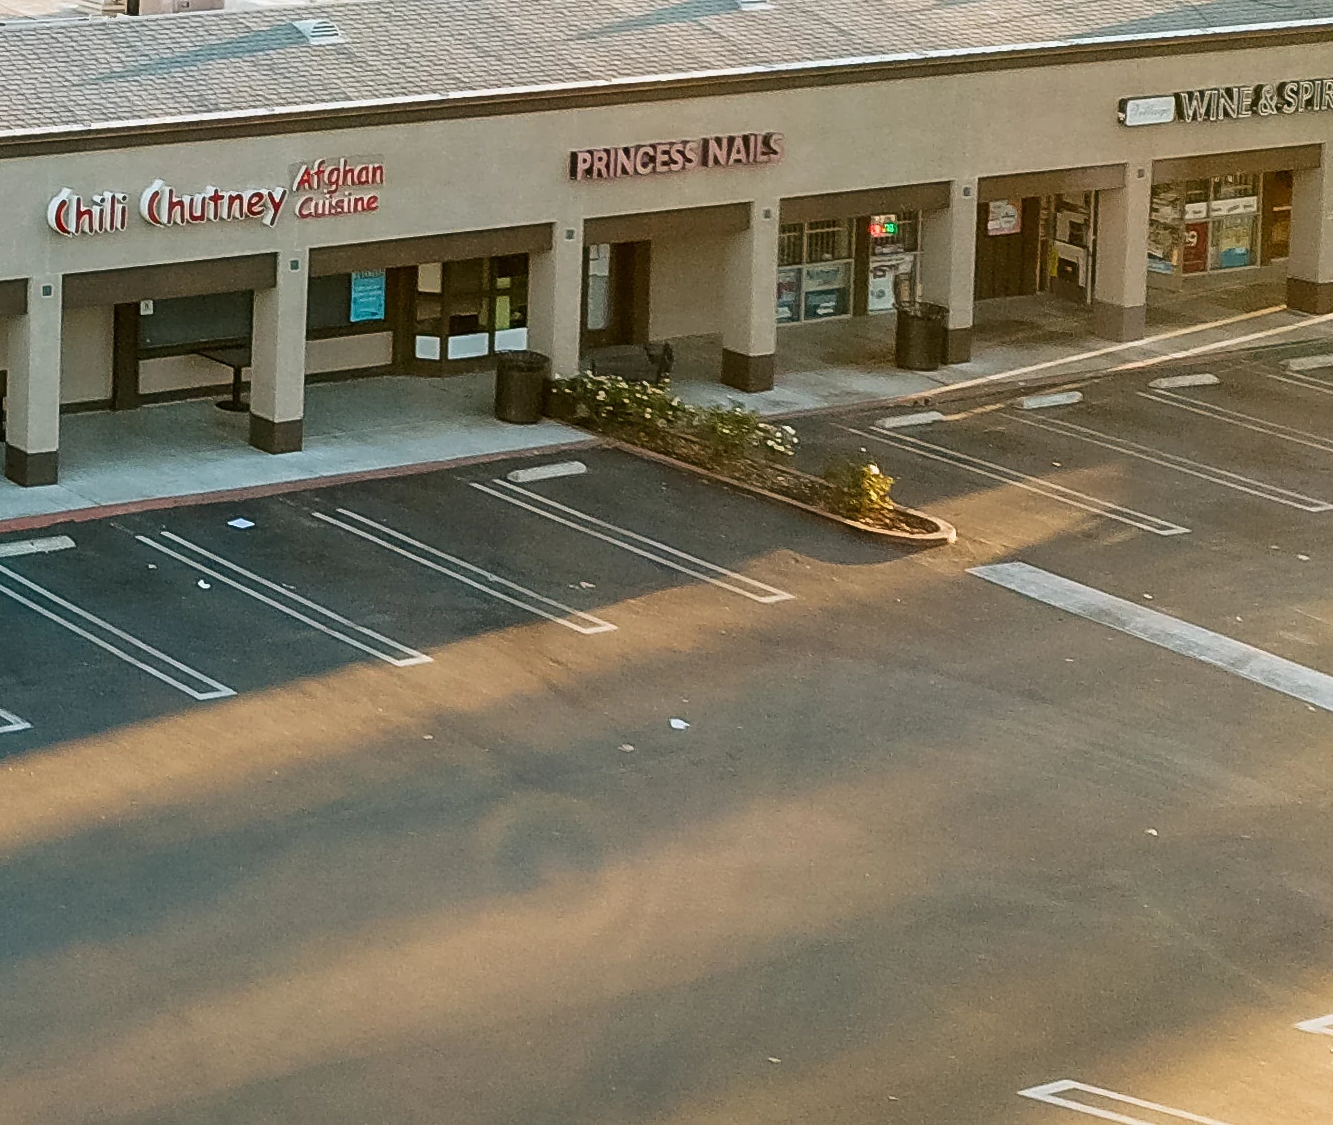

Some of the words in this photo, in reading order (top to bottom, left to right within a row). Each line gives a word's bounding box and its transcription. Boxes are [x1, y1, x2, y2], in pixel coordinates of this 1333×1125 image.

[1178, 87, 1254, 123] WINE
[1256, 83, 1279, 116] &
[569, 140, 703, 181] PRINCESS
[703, 132, 785, 168] NAILS
[293, 159, 384, 195] Afghan
[47, 187, 129, 236] Chili
[140, 179, 287, 227] Chutney
[294, 191, 380, 219] Cuisine
